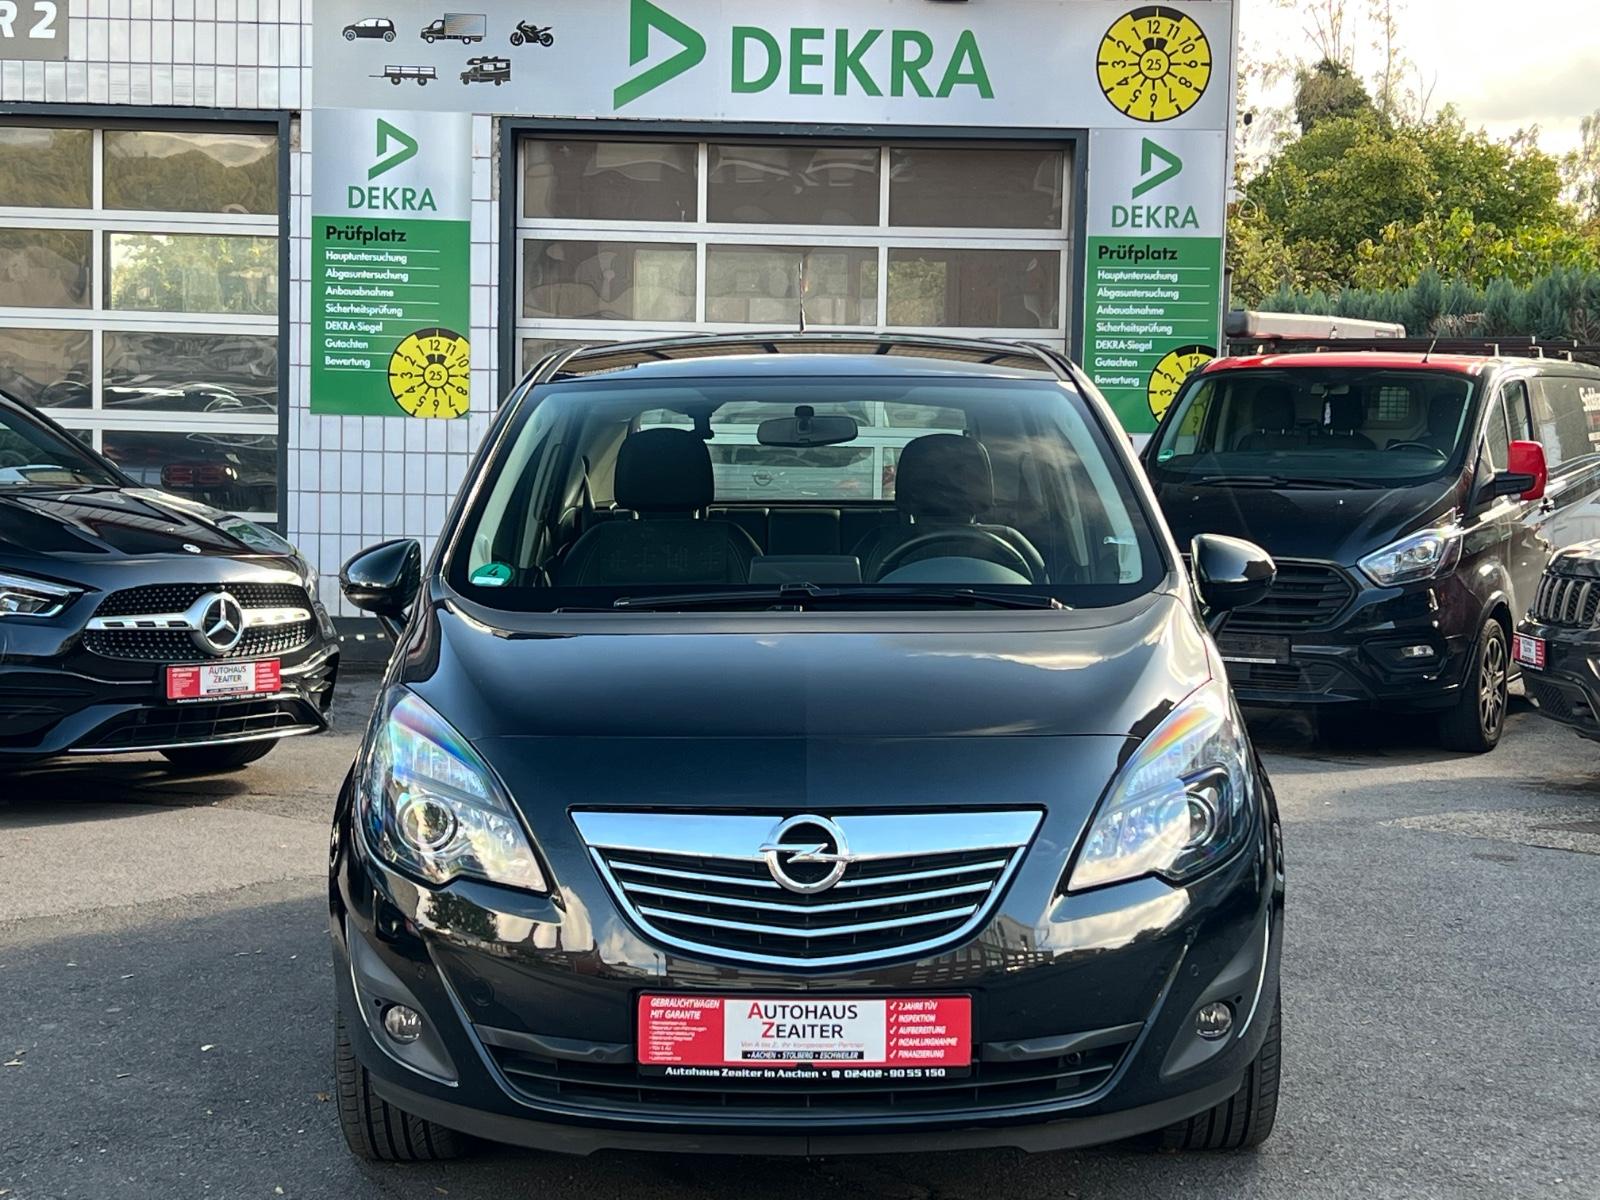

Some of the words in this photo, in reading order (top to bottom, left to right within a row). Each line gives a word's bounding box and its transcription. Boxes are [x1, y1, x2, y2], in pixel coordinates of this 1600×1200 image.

[29, 0, 57, 39] 2
[1131, 26, 1141, 40] 1
[1146, 20, 1160, 34] 12
[1167, 23, 1180, 40] 11
[1116, 40, 1132, 53] 2
[1179, 36, 1196, 54] 10
[731, 26, 995, 99] DEKRA
[1111, 60, 1127, 68] 3
[1146, 58, 1161, 71] 25
[1116, 76, 1130, 86] 4
[1178, 76, 1192, 88] 8
[1129, 89, 1142, 103] 5
[1169, 88, 1177, 103] 7
[348, 185, 437, 211] DEKRA
[1111, 205, 1200, 229] DEKRA
[325, 225, 407, 245] Prüfplatz
[325, 251, 408, 264] Hauptuntersuchung
[1098, 244, 1178, 264] Prüfplatz
[325, 268, 409, 282] Abgasuntersuchung
[1097, 270, 1178, 283] Hauptuntersuchung
[325, 286, 394, 297] Anbauabnahme
[1097, 287, 1180, 300] Abgasuntersuchung
[325, 303, 403, 317] Sicherheitsprüfung
[1096, 304, 1165, 315] Anbauabnahme
[325, 321, 383, 333] DEKRA-Siegel
[1096, 322, 1173, 335] Sicherheitsprüfung
[324, 338, 368, 349] Gutachten
[429, 340, 441, 351] 12
[446, 342, 457, 356] 11
[1095, 339, 1153, 352] DEKRA-Siegel
[416, 345, 425, 356] 1
[324, 356, 371, 368] Bewertung
[404, 356, 416, 366] 2
[456, 353, 470, 368] 10
[1095, 357, 1138, 367] Gutachten
[1189, 356, 1200, 368] 12
[1176, 362, 1185, 373] 1
[429, 371, 442, 381] 25
[1094, 375, 1140, 387] Bewertung
[1164, 373, 1176, 384] 2
[404, 385, 416, 393] 4
[456, 386, 468, 396] 8
[416, 396, 426, 407] 5
[449, 395, 456, 408] 7
[209, 665, 247, 675] AUTOHAUS
[650, 998, 720, 1009] GEBRAUCHTWAGEN
[924, 1001, 938, 1010] TÜV
[650, 1010, 664, 1019] MIT
[664, 1010, 701, 1020] GARANTIE
[748, 1002, 858, 1020] AUTOHAUS
[898, 1014, 936, 1023] INSPEKTION
[761, 1022, 844, 1038] ZEAITER
[898, 1025, 946, 1035] AUFBEREITUNG
[898, 1037, 958, 1046] INZAHLUNGNAHME
[751, 1051, 776, 1059] AACHEN
[782, 1051, 813, 1059] STOLBERG
[820, 1051, 859, 1059] ESCHWEILER
[898, 1050, 944, 1059] FINANZIERUNG
[665, 1067, 720, 1076] Autohaus
[721, 1068, 762, 1077] Zeaiter
[764, 1069, 775, 1077] in
[777, 1069, 819, 1079] Aachen
[844, 1069, 882, 1078] 02402
[890, 1069, 905, 1078] 90
[925, 1068, 946, 1077] 150
